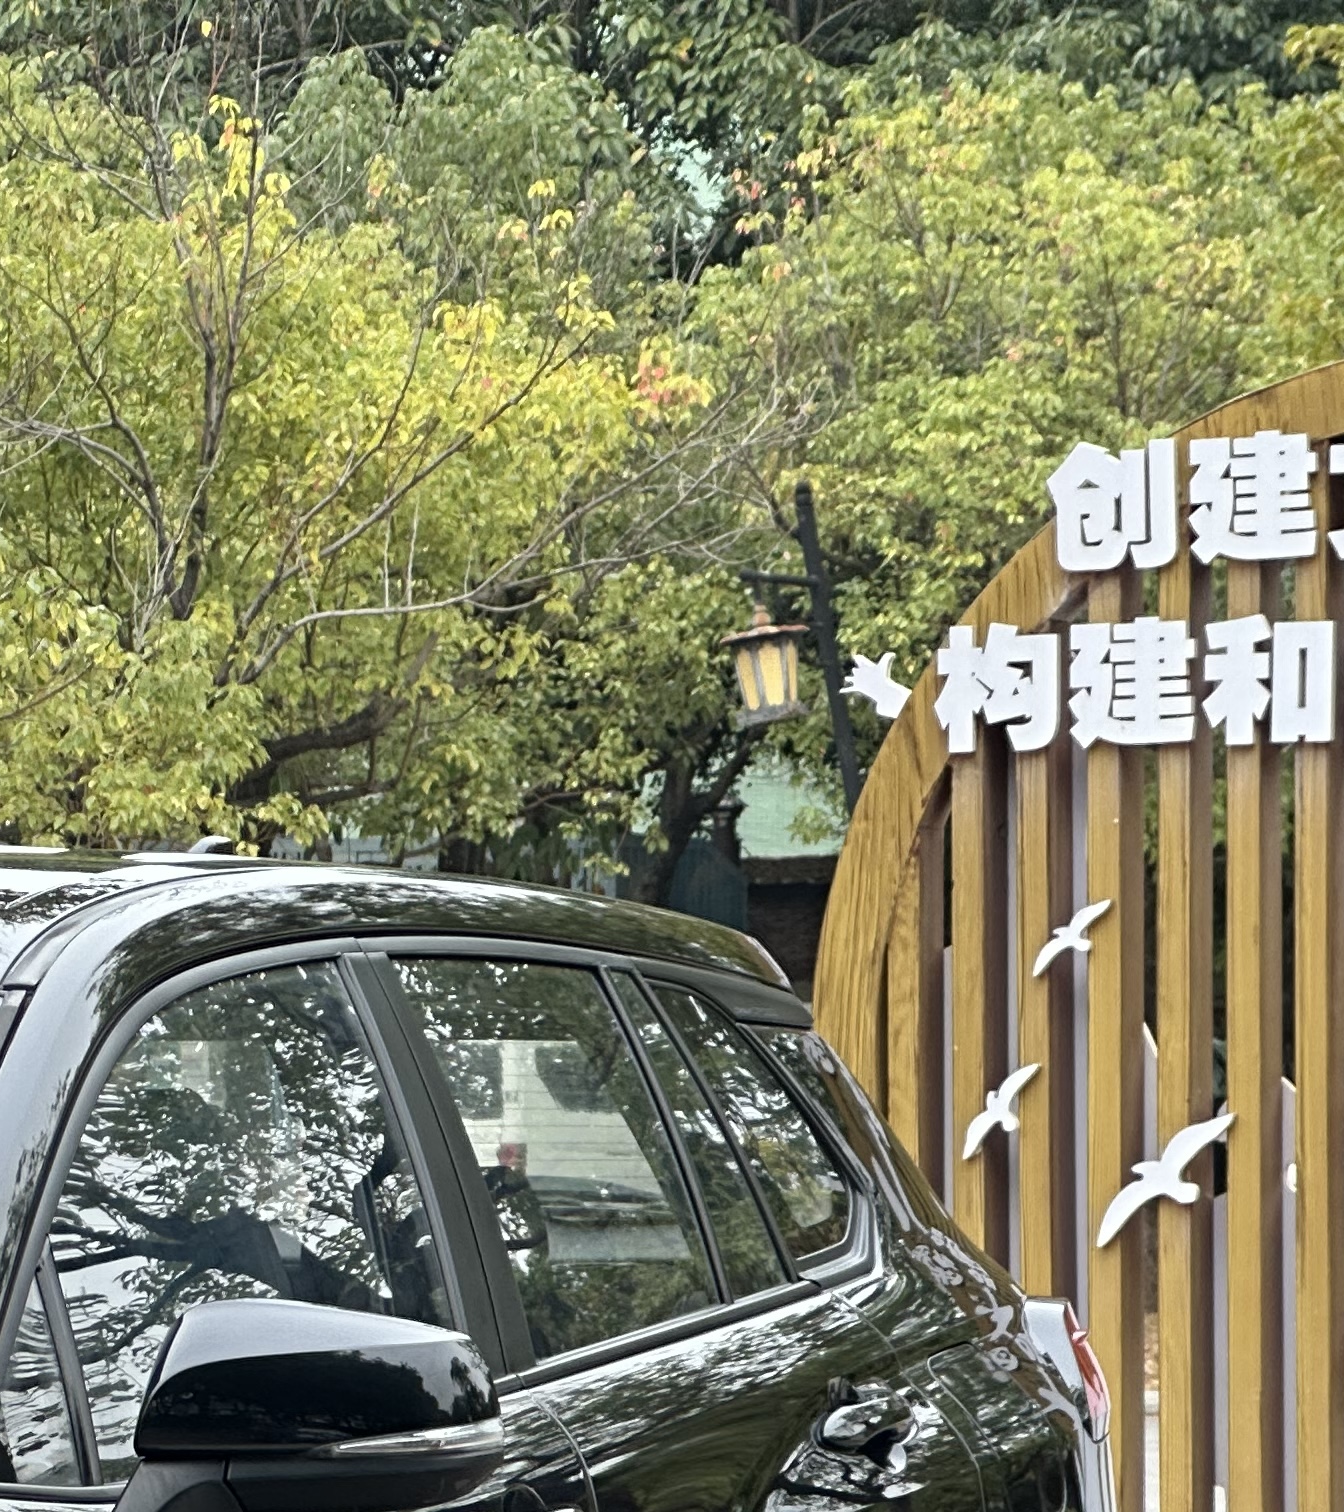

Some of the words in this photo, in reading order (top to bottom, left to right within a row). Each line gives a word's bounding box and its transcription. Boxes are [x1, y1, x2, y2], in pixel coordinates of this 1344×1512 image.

[1047, 430, 1344, 571] 创建
[934, 614, 1336, 753] 构建和
